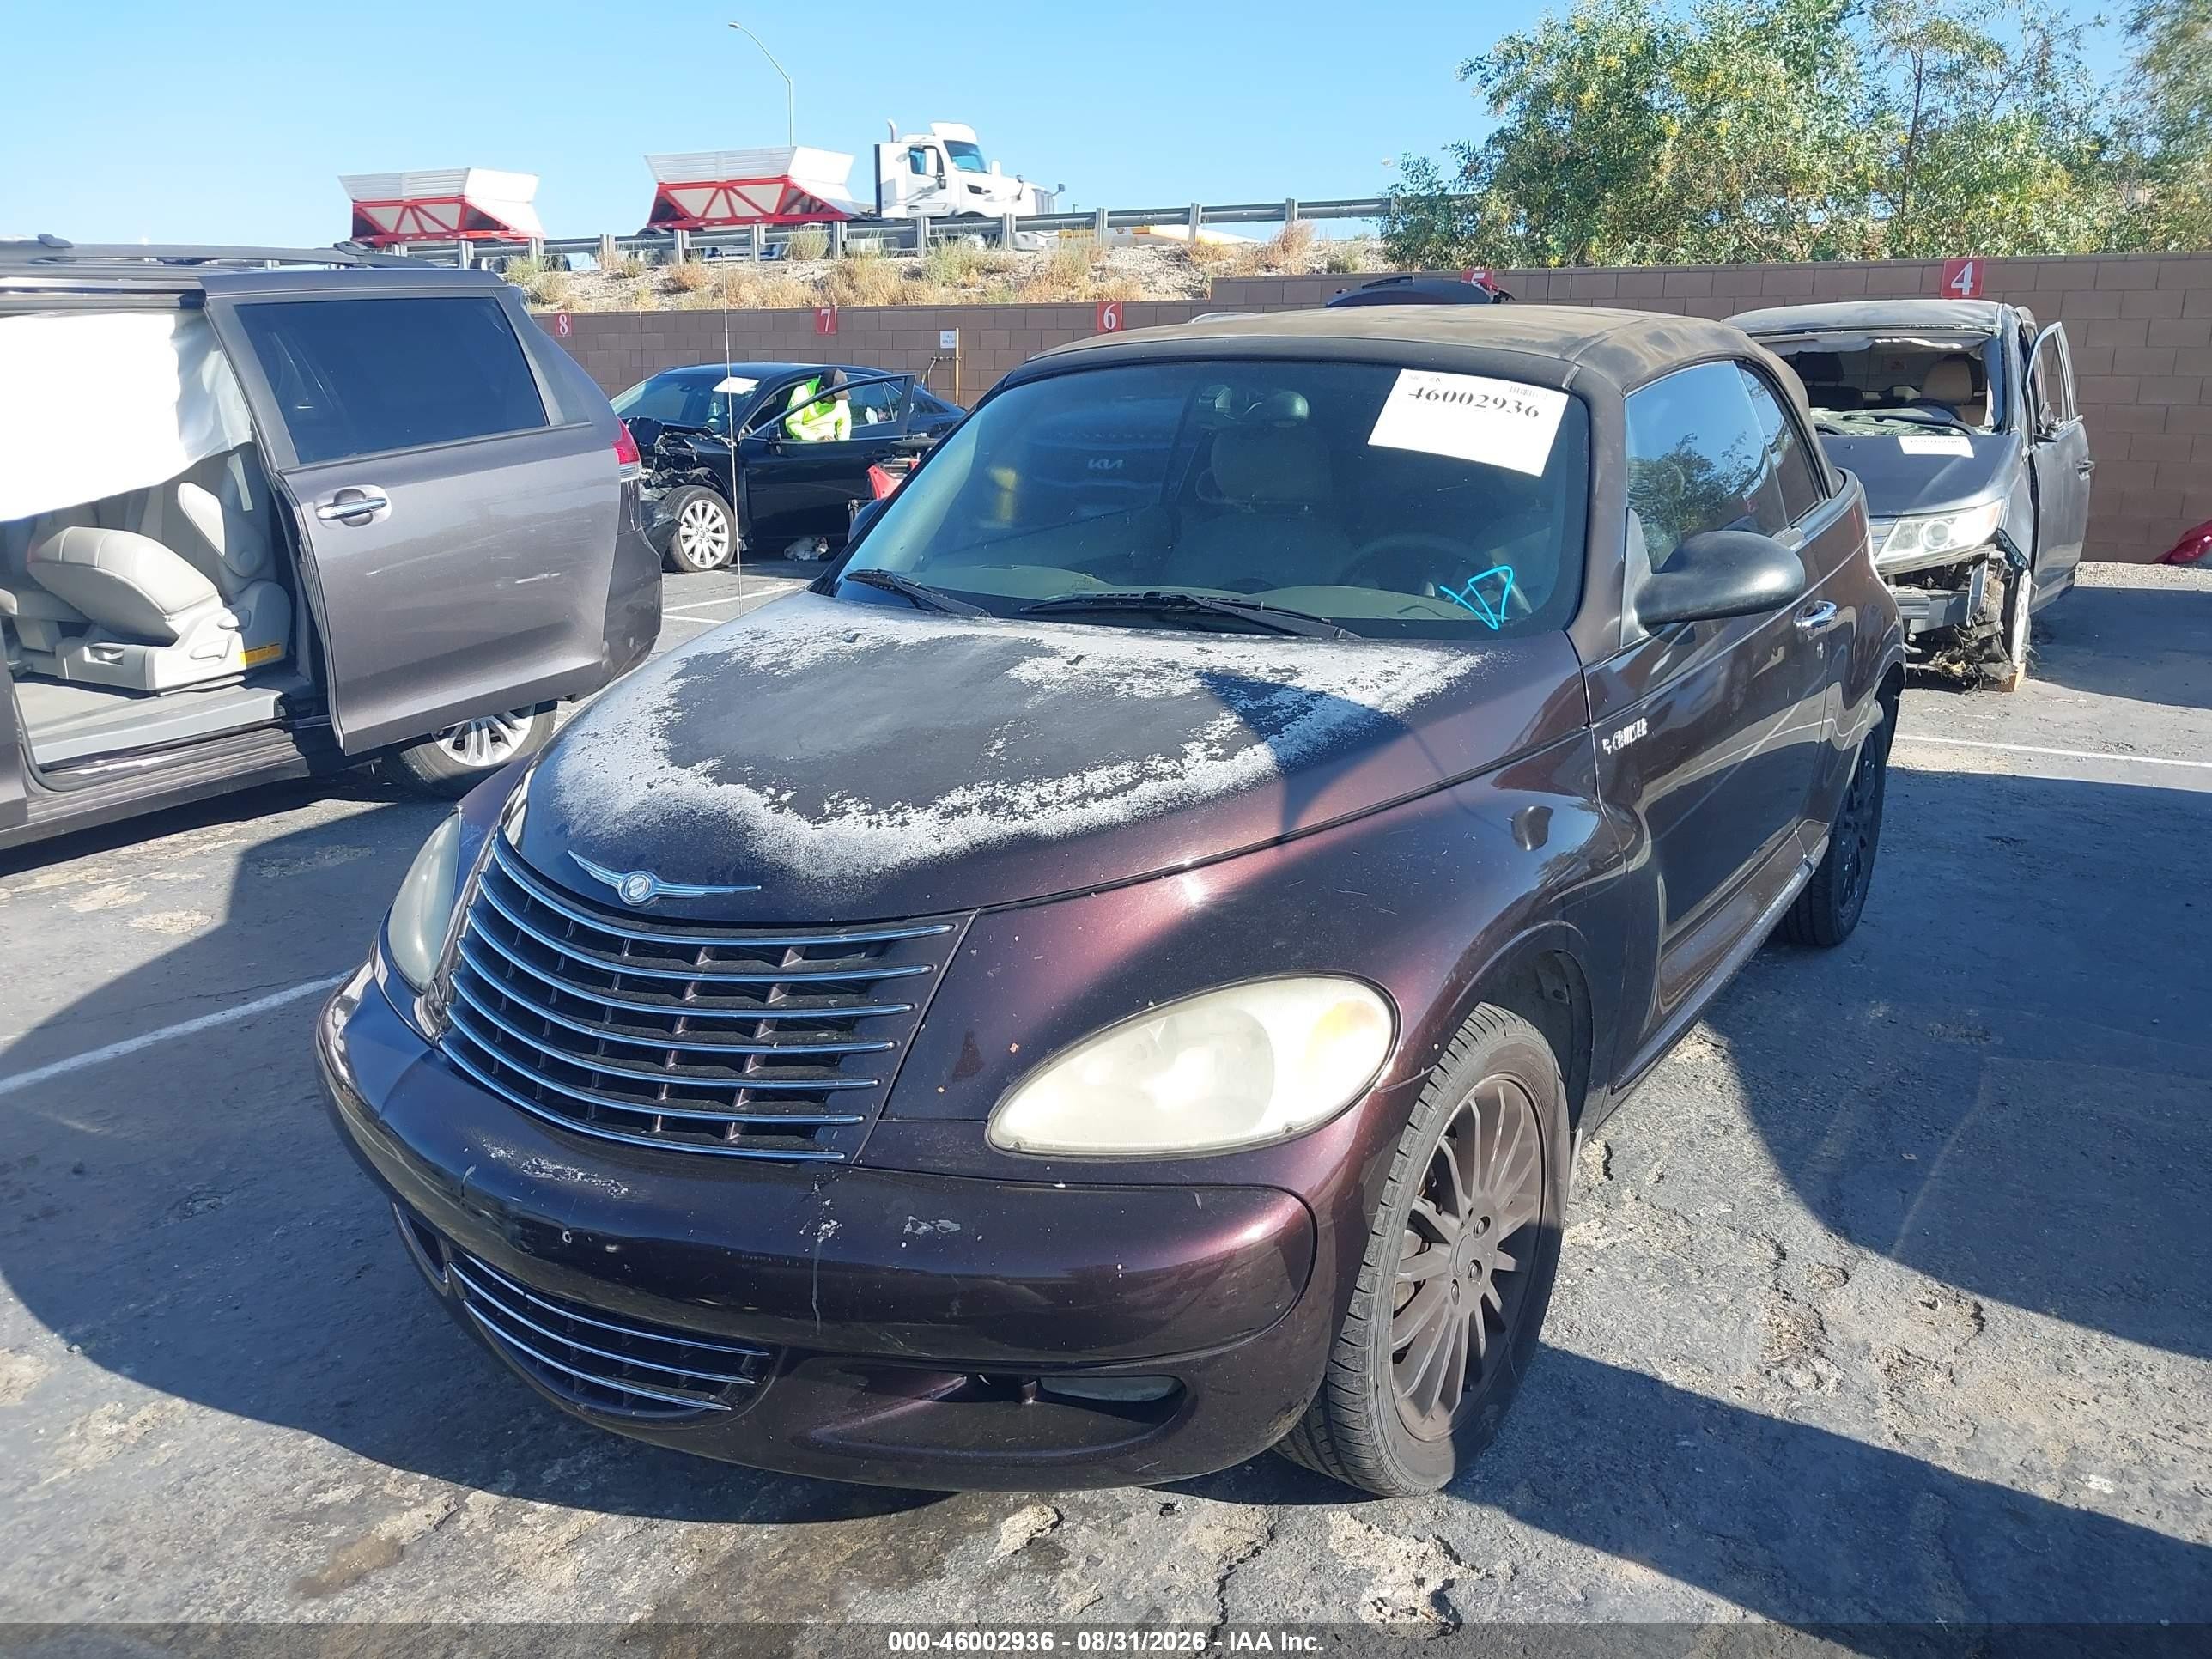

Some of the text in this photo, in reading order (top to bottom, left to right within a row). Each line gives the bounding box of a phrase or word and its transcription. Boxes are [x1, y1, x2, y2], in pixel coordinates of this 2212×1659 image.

[1950, 261, 1974, 295] 4
[558, 314, 568, 335] 8
[820, 308, 831, 332] 7
[1103, 303, 1116, 330] 6
[1408, 387, 1540, 418] 46002936
[1612, 717, 1648, 750] CRUISER
